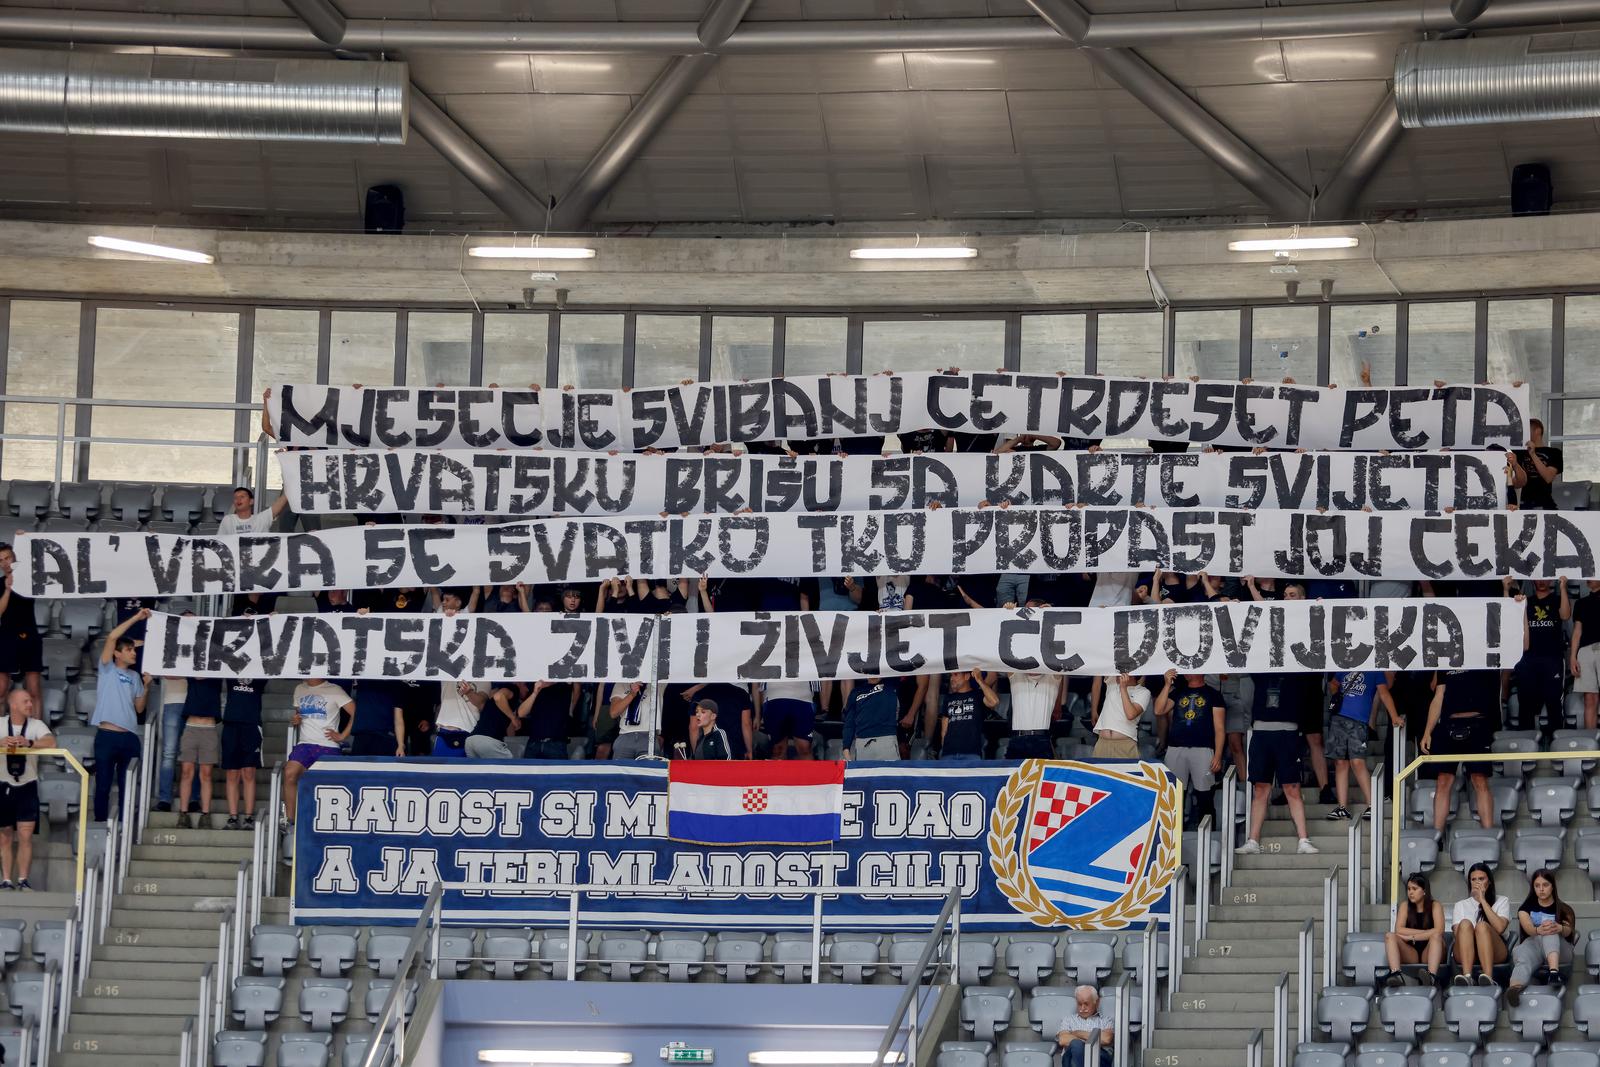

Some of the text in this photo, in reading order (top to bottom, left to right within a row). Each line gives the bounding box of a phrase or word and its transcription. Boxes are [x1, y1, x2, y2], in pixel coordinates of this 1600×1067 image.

[632, 377, 903, 448] SVIBANJ
[1339, 386, 1524, 448] PETA
[300, 453, 1498, 514] HRVATSKU BRIŠU SA KARTE SVIJETA
[31, 509, 1596, 597] AL' VARA SE SVATKO TKO PROPAST JOJ ČEKA
[161, 615, 517, 678] HRVATSKA
[693, 617, 711, 678] I
[737, 611, 971, 680] ŽIVJET
[233, 685, 254, 693] adidas
[313, 786, 532, 838] RADOST
[540, 791, 598, 839] SI
[872, 790, 986, 840] DAO
[313, 846, 359, 894] A
[367, 847, 444, 895] JA
[588, 851, 849, 900] MLADOST
